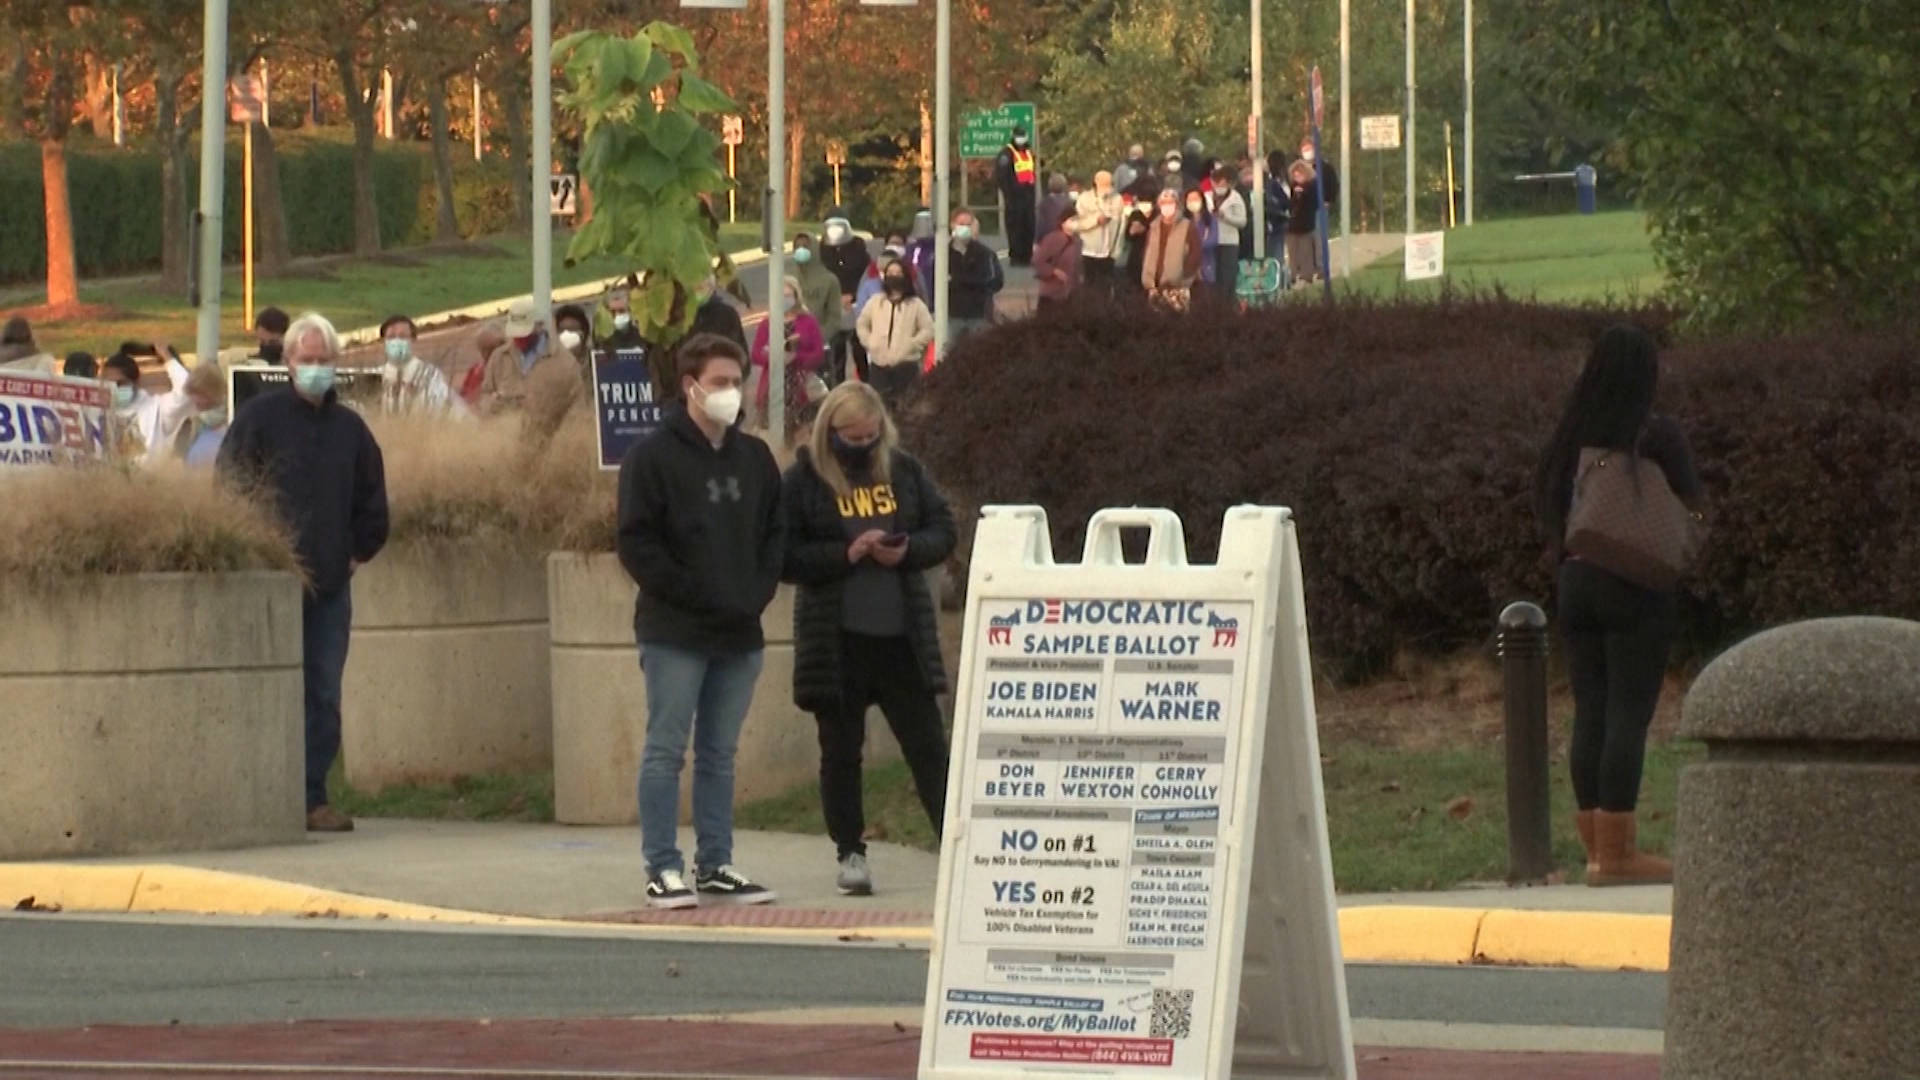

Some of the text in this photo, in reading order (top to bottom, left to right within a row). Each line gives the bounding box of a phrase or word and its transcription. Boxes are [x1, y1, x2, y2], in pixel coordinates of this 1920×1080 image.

[600, 383, 653, 404] TRUM
[607, 407, 661, 422] PENCE
[0, 403, 107, 453] BIDEN
[1026, 600, 1205, 625] DEMOCRATIC
[1023, 634, 1200, 655] SAMPLE BALLOT
[987, 681, 1097, 701] JOE BIDEN
[1145, 681, 1200, 697] MARK
[986, 706, 1095, 720] KAMALA HARRIS
[1120, 699, 1221, 721] WARNER
[1000, 763, 1035, 778] DON
[1063, 765, 1135, 780] JENNIFER
[1155, 767, 1206, 782] GERRY
[985, 781, 1046, 797] BEYER
[1061, 783, 1135, 798] WEXTON
[1140, 784, 1218, 800] CONNOLLY
[1001, 830, 1097, 853] NO on #1
[1135, 838, 1171, 848] SHEILA
[974, 855, 990, 866] Say
[992, 856, 1006, 867] NO
[1008, 857, 1018, 866] to
[992, 881, 1095, 905] YES on #2
[1130, 895, 1166, 905] PRADIP
[944, 1009, 1137, 1033] FFXVotes.org/MyBallot
[1120, 1051, 1170, 1064] 4VA-VOTE
